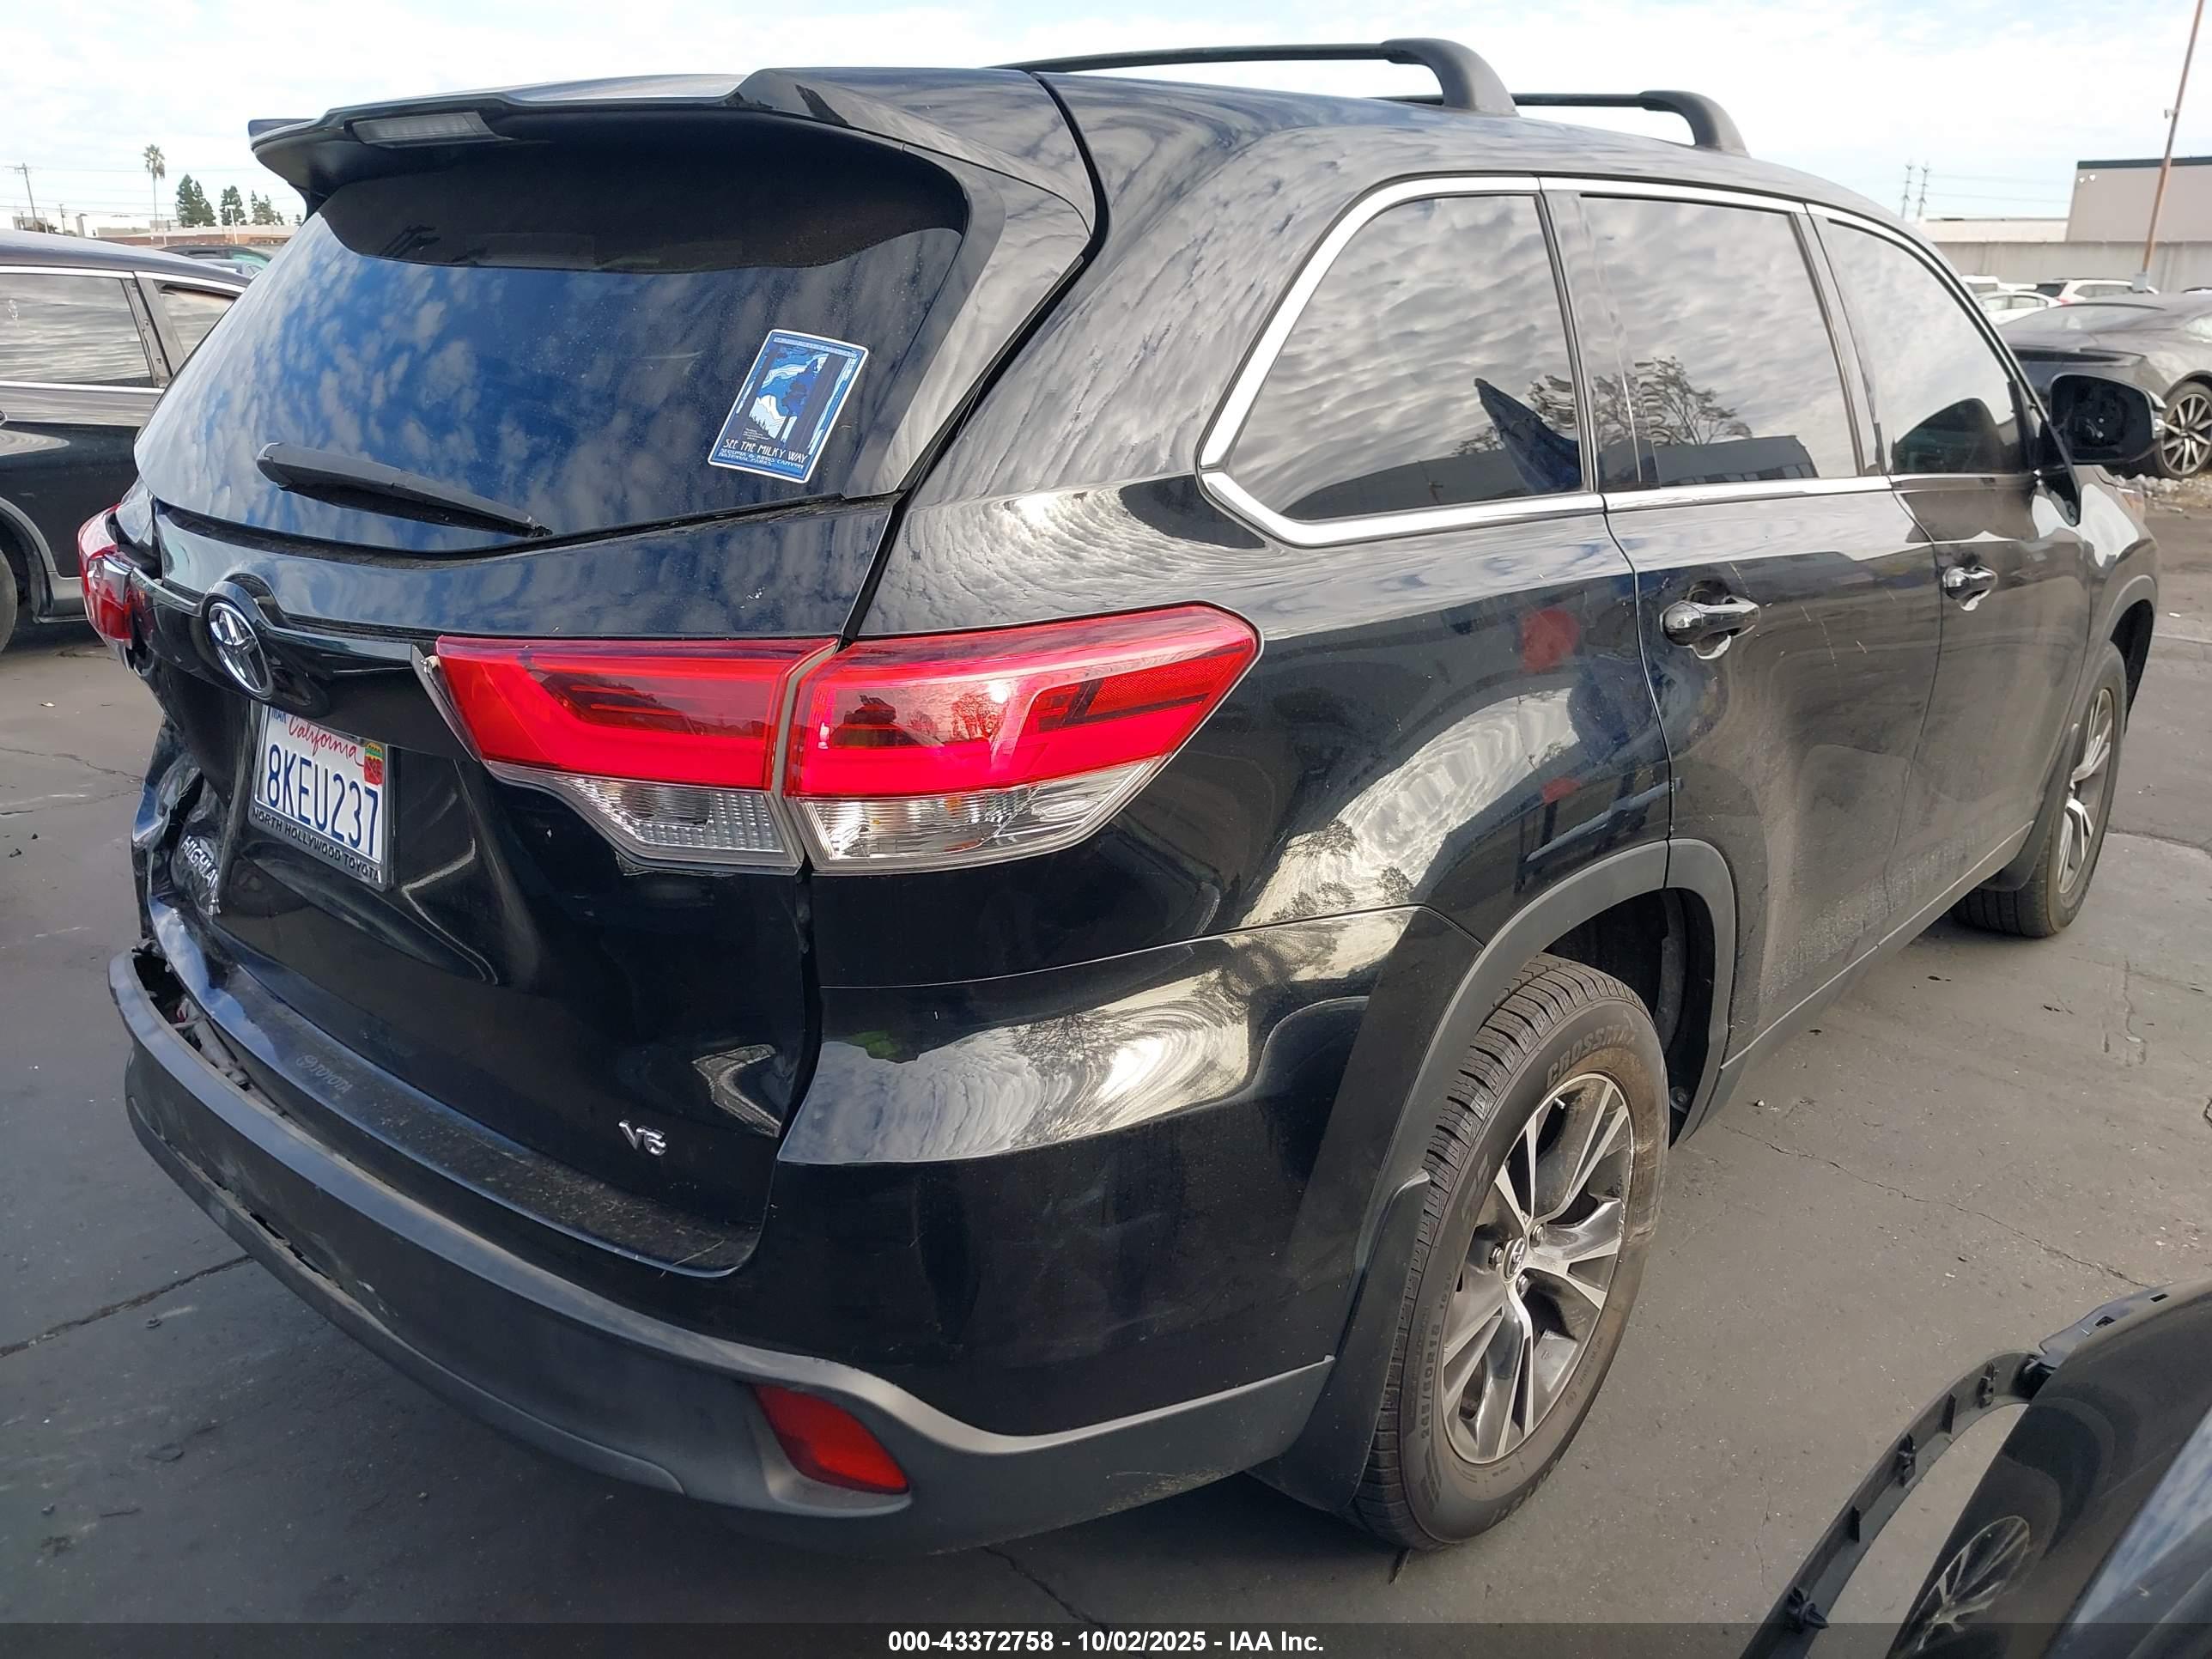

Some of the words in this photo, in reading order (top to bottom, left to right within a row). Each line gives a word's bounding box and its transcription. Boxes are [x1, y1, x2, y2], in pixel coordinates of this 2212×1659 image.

[723, 439, 738, 449] SEE
[741, 441, 757, 453] THE
[757, 444, 787, 459] MILKY
[787, 451, 808, 464] WAY
[289, 716, 364, 767] California
[266, 744, 379, 856] 8KEU237
[252, 806, 283, 832] NORTH
[285, 823, 343, 860] HOLLYWOOD
[344, 852, 382, 884] TOYOTA
[309, 1061, 354, 1094] TOYOTA
[618, 1119, 667, 1157] V6
